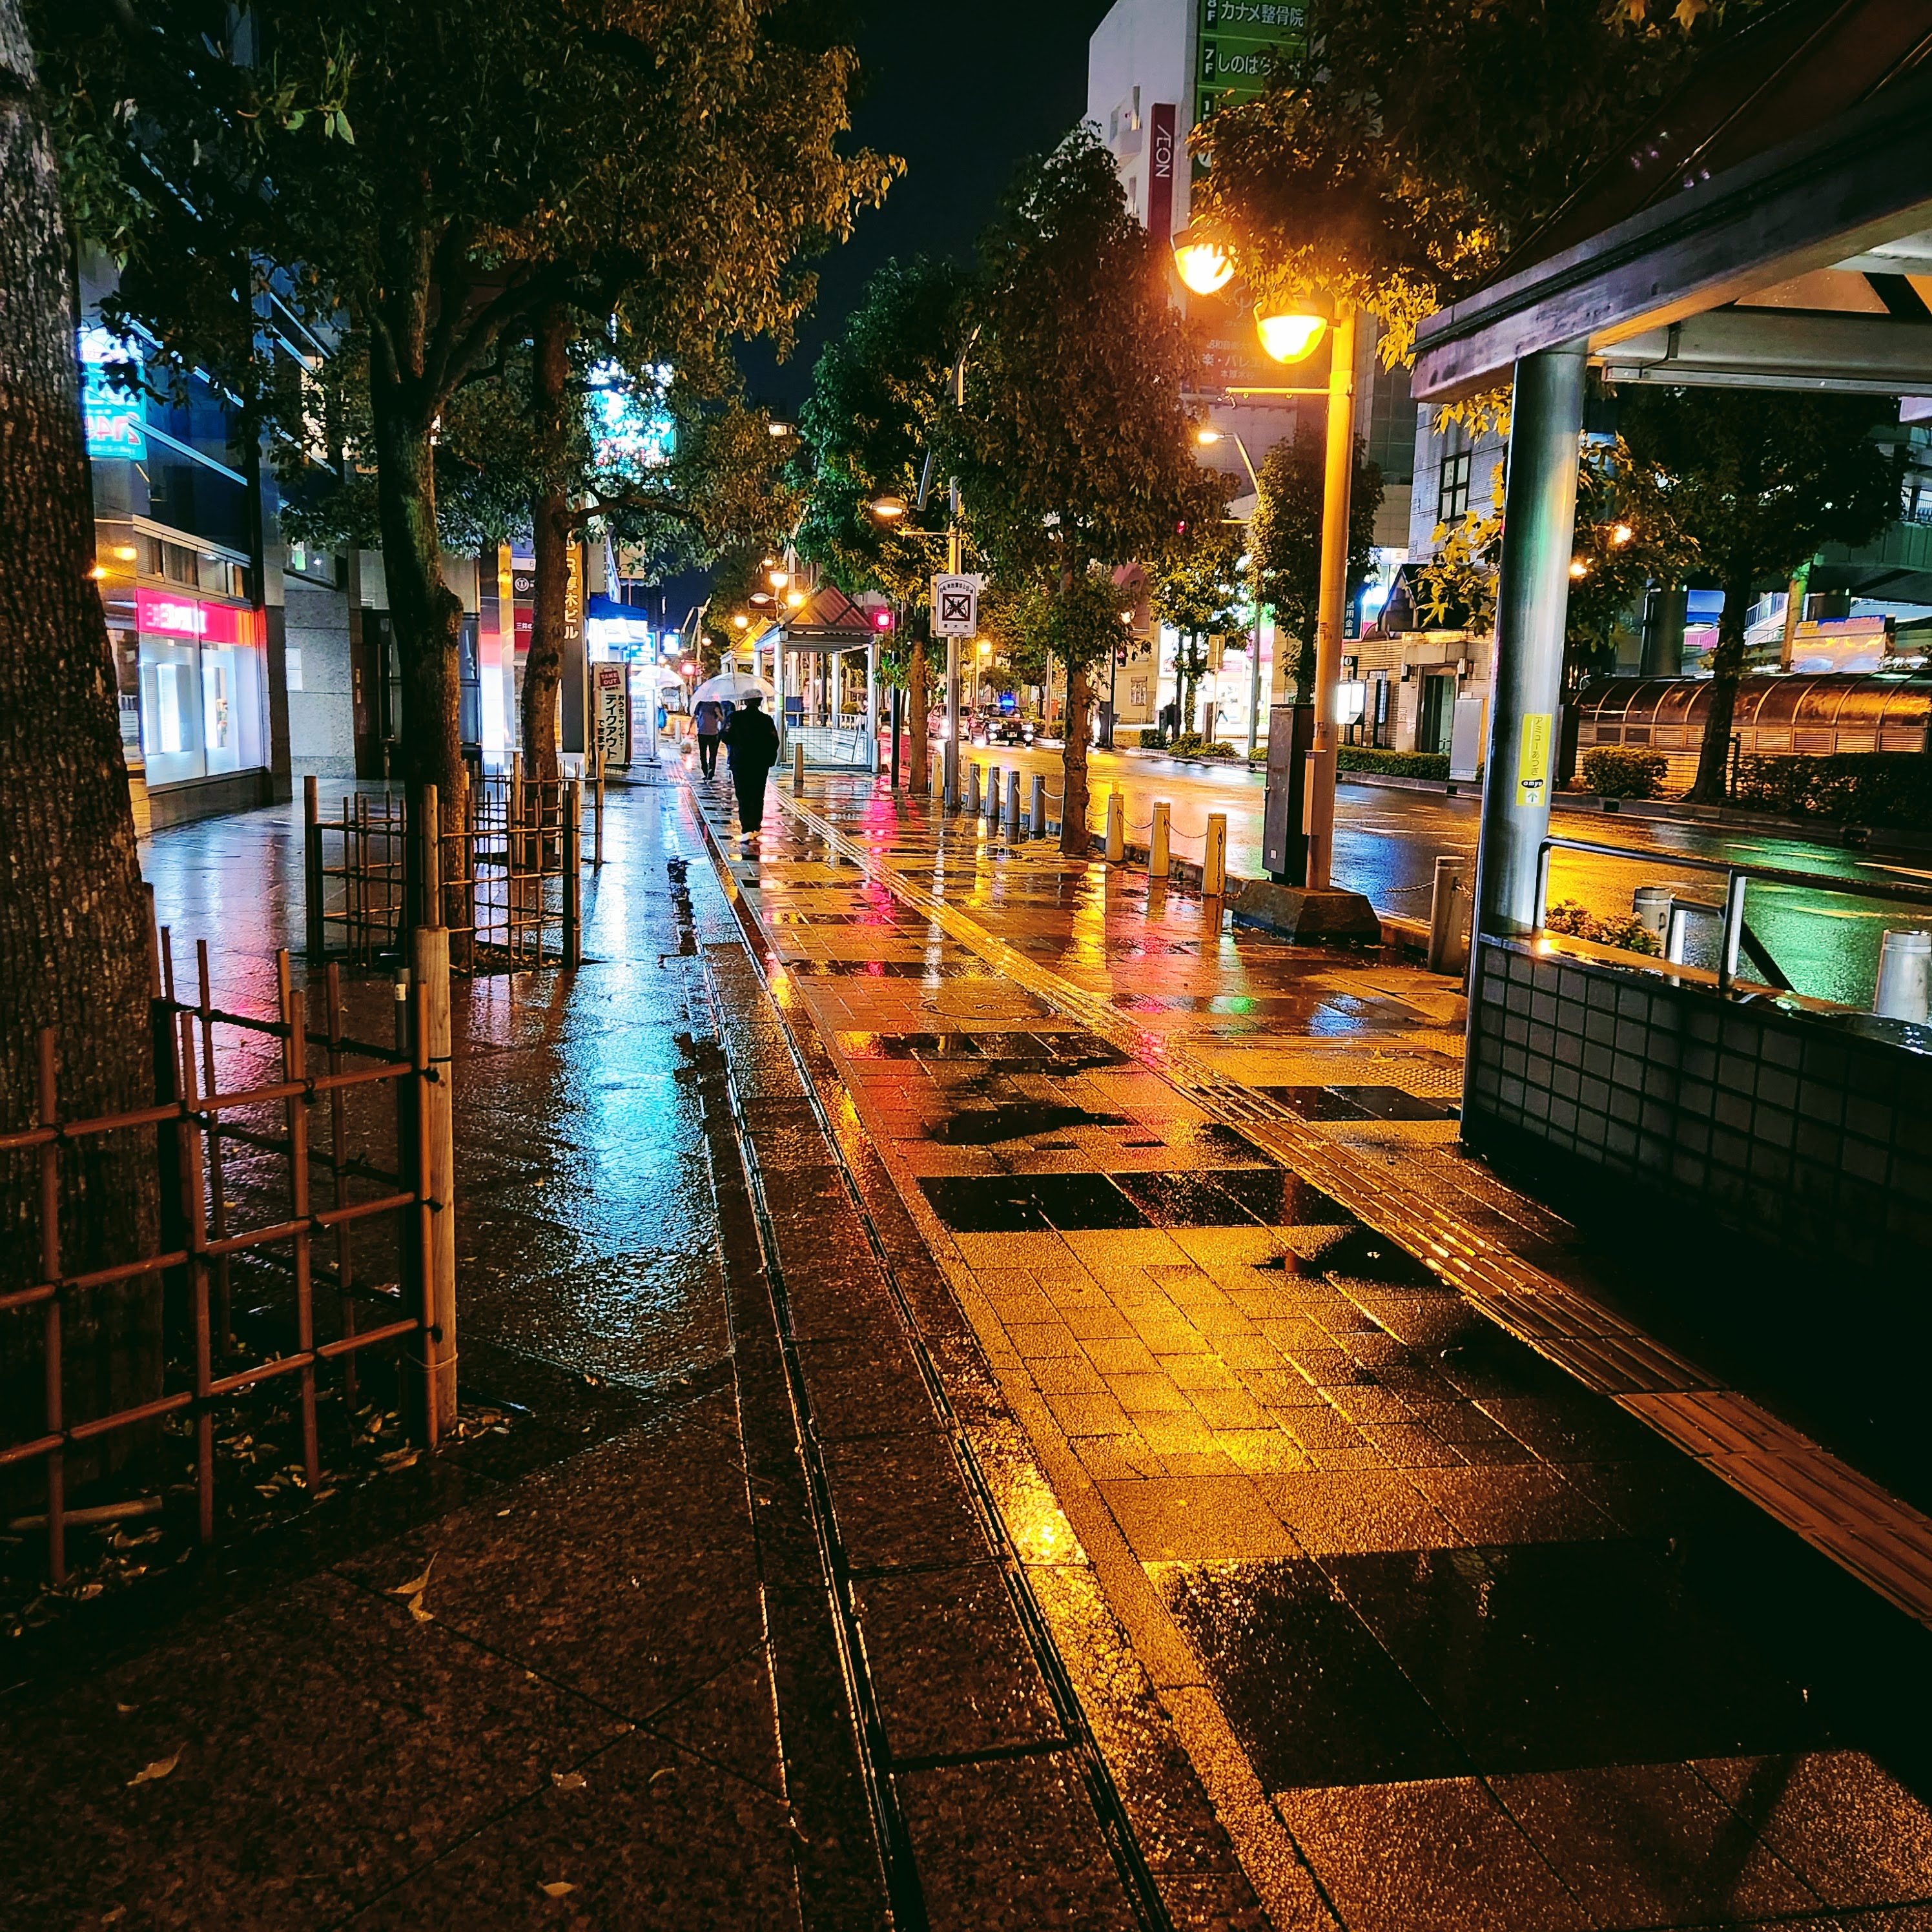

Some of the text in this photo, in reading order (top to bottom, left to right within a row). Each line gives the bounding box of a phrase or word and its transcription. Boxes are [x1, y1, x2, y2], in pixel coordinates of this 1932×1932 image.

[1221, 2, 1304, 27] カナメ整骨院
[1205, 49, 1215, 74] 7F
[597, 719, 605, 752] できます
[605, 694, 617, 759] テイクアウト
[1531, 717, 1543, 776] アミューあつぎ
